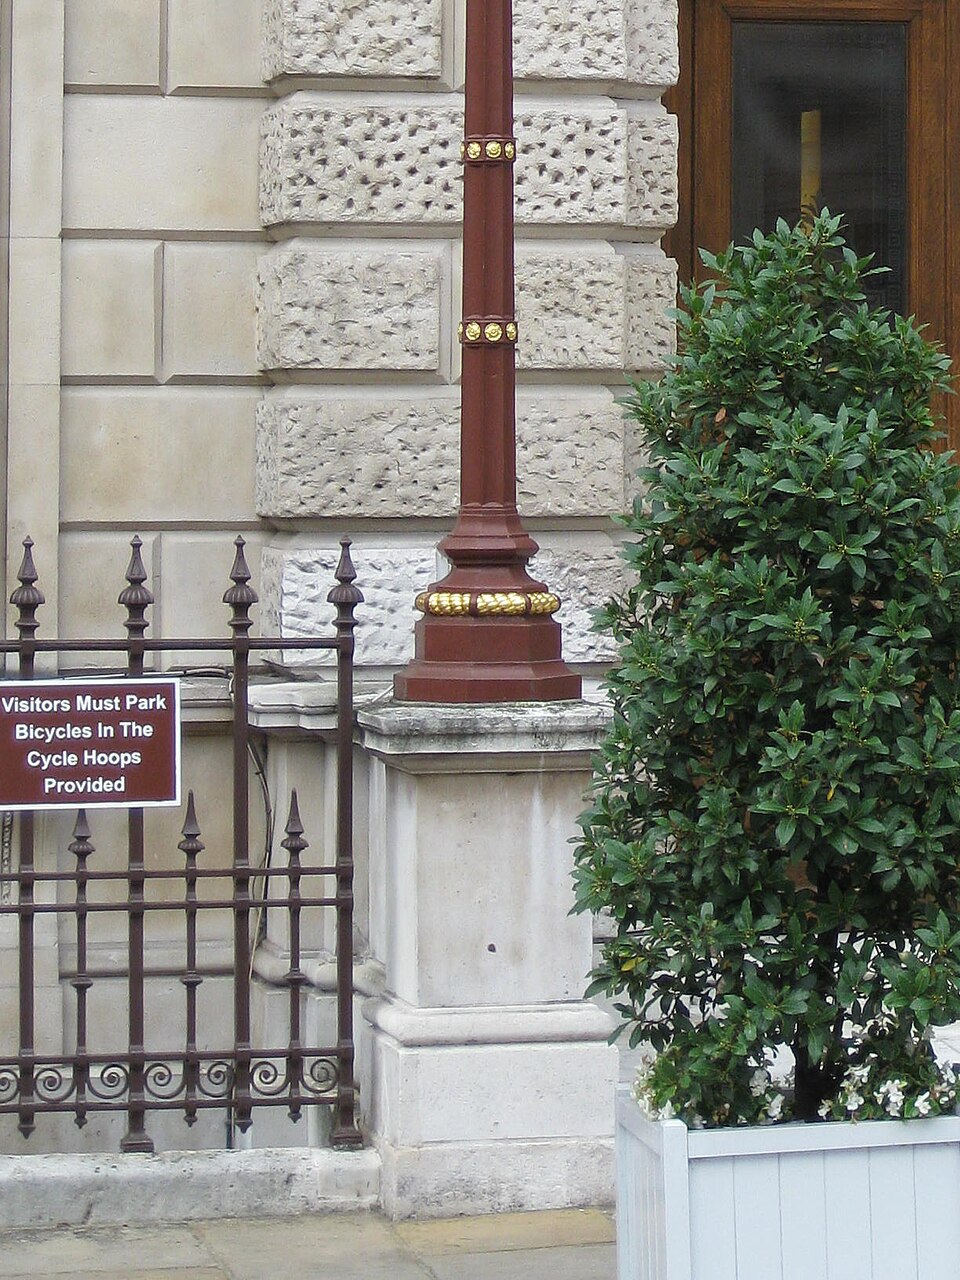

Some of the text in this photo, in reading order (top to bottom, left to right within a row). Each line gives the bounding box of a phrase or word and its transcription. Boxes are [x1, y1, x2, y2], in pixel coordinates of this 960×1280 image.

[1, 694, 167, 713] Visitors Must Park
[15, 721, 154, 743] Bicycles In The
[27, 749, 142, 770] Cycle Hoops
[44, 776, 125, 793] Provided
